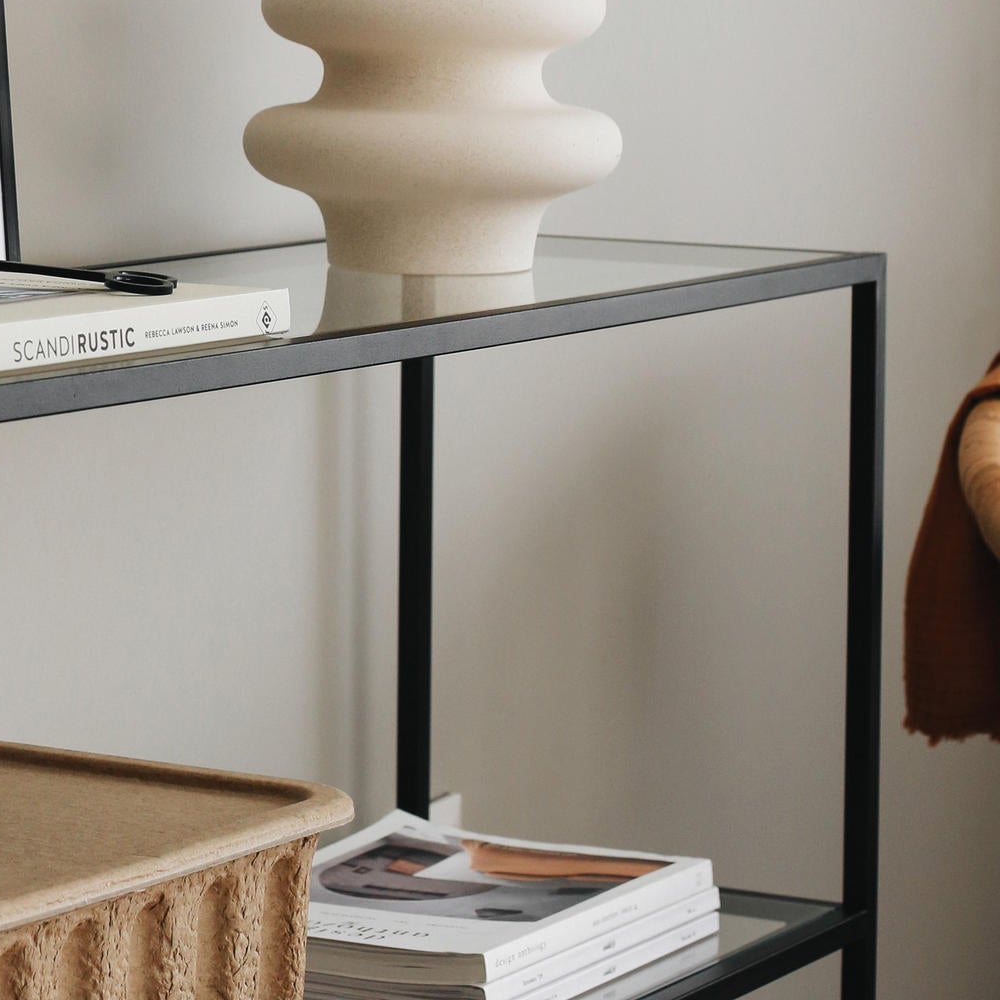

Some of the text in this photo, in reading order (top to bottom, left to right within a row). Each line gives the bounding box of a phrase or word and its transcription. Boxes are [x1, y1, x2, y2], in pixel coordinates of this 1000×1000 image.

[145, 320, 239, 339] REBECCA LAWSON & REENA SIMON
